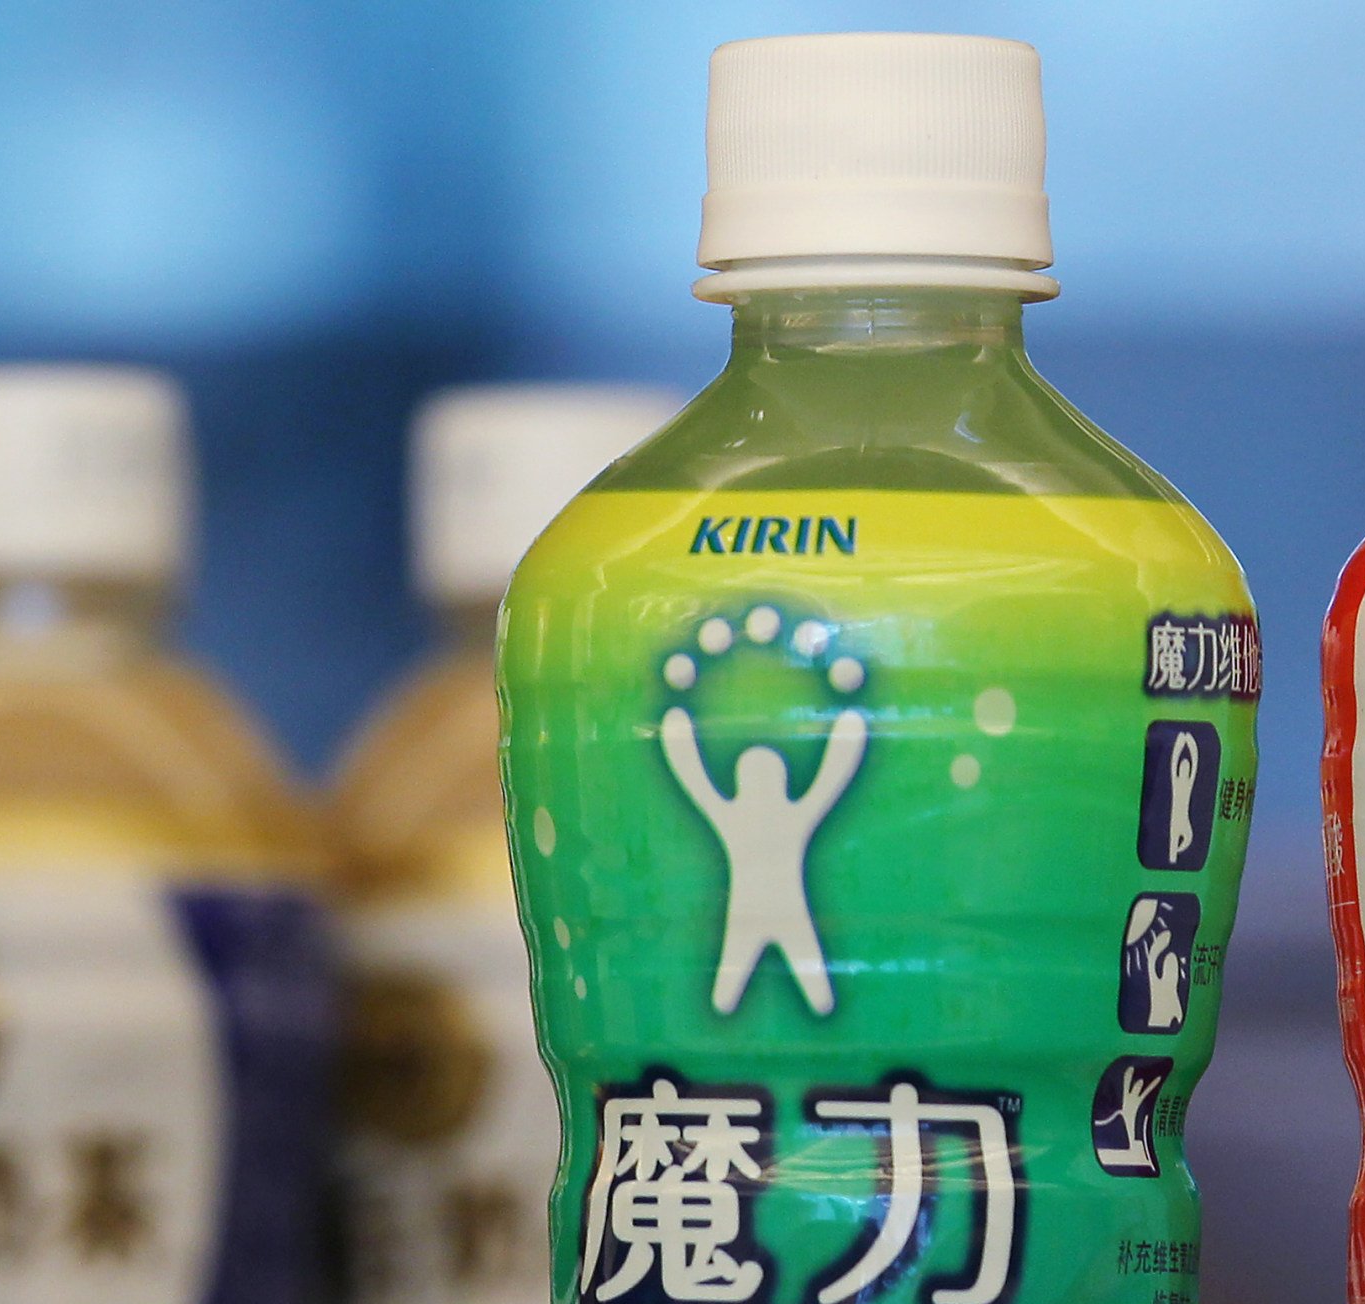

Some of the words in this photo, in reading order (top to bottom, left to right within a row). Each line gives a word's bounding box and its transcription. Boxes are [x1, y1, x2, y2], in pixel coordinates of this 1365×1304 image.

[689, 516, 857, 556] KIRIN
[1149, 620, 1263, 693] 魔力维他
[997, 1096, 1022, 1113] TM
